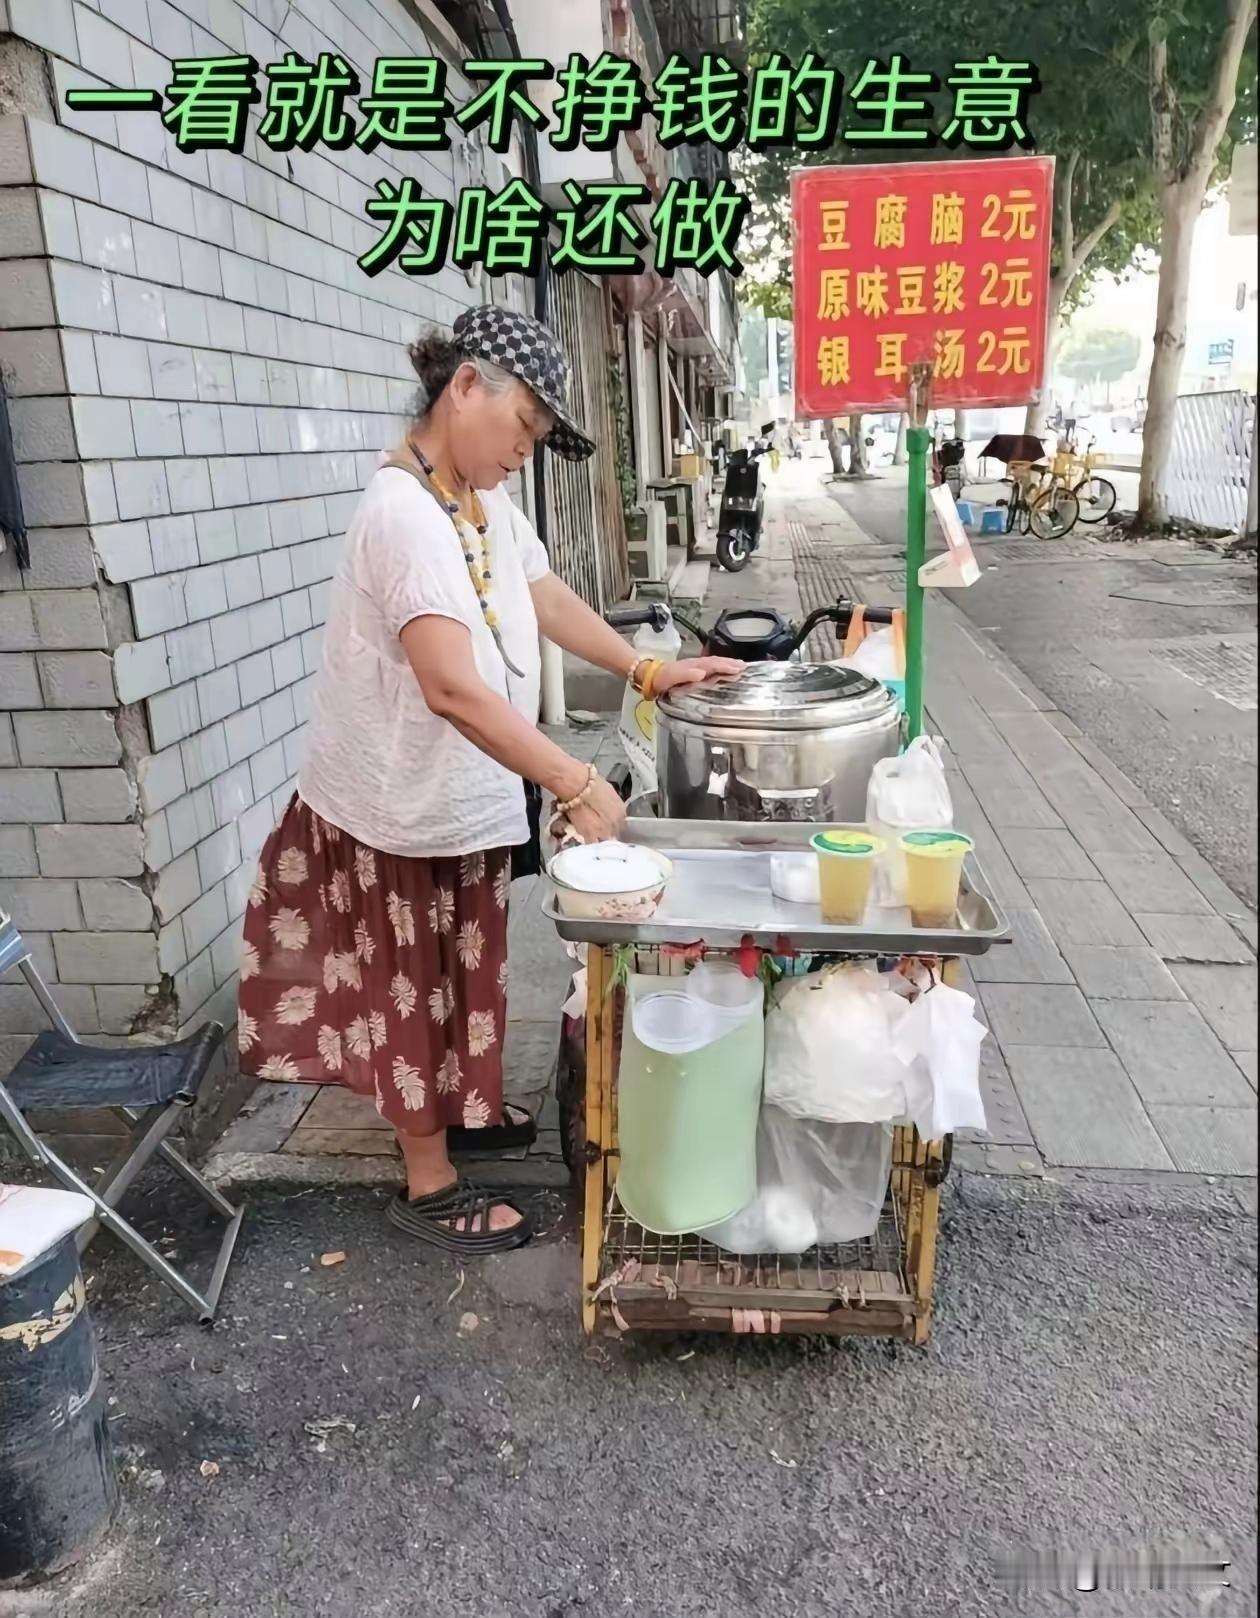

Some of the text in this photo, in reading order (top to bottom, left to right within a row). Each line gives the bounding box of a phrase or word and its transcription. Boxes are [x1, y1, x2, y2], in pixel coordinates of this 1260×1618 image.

[817, 189, 1037, 250] 豆腐脑 2元
[817, 258, 1033, 321] 原味豆浆 2元
[817, 326, 1031, 386] 银耳汤 2元
